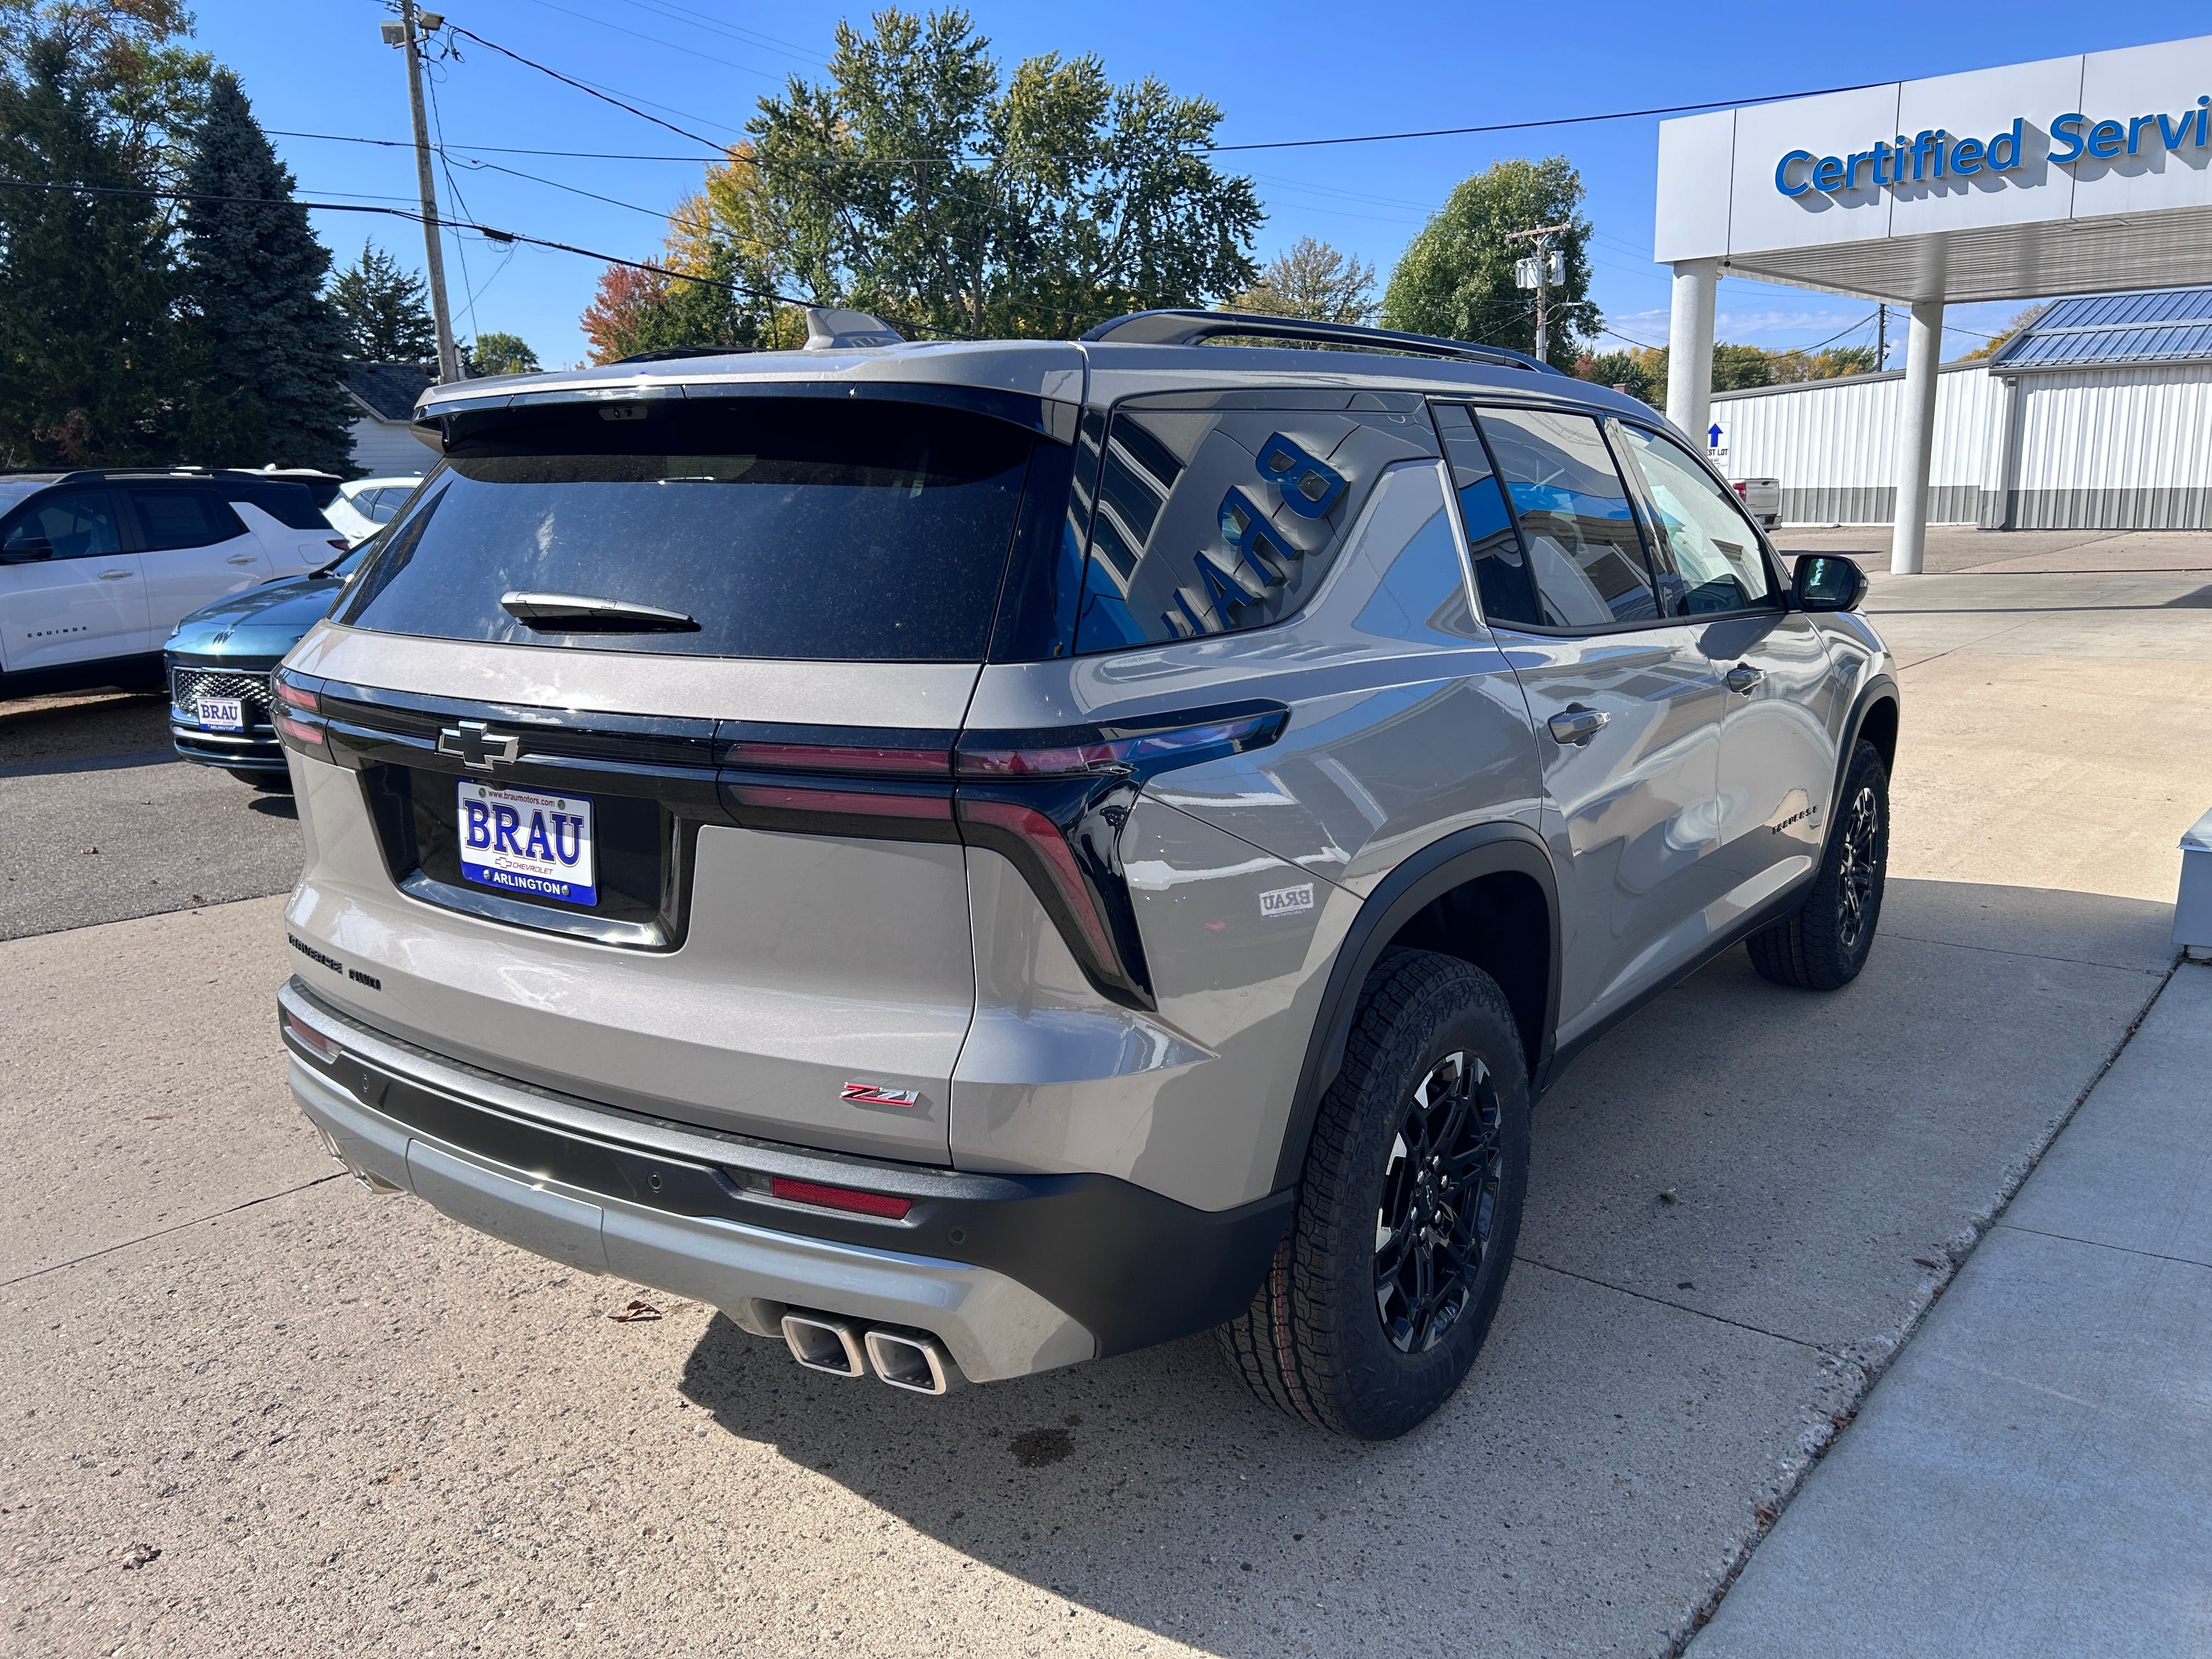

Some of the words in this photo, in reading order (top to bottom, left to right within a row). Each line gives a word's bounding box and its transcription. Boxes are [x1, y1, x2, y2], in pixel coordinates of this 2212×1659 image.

[1775, 117, 2024, 197] Certified
[2046, 95, 2210, 164] Servi
[27, 626, 87, 638] EQUINOX
[201, 704, 238, 720] BRAU
[488, 790, 555, 807] www.braumotors.com
[463, 798, 584, 867] BRAU
[512, 862, 554, 874] CHEVROLET
[493, 871, 560, 895] ARLINGTON
